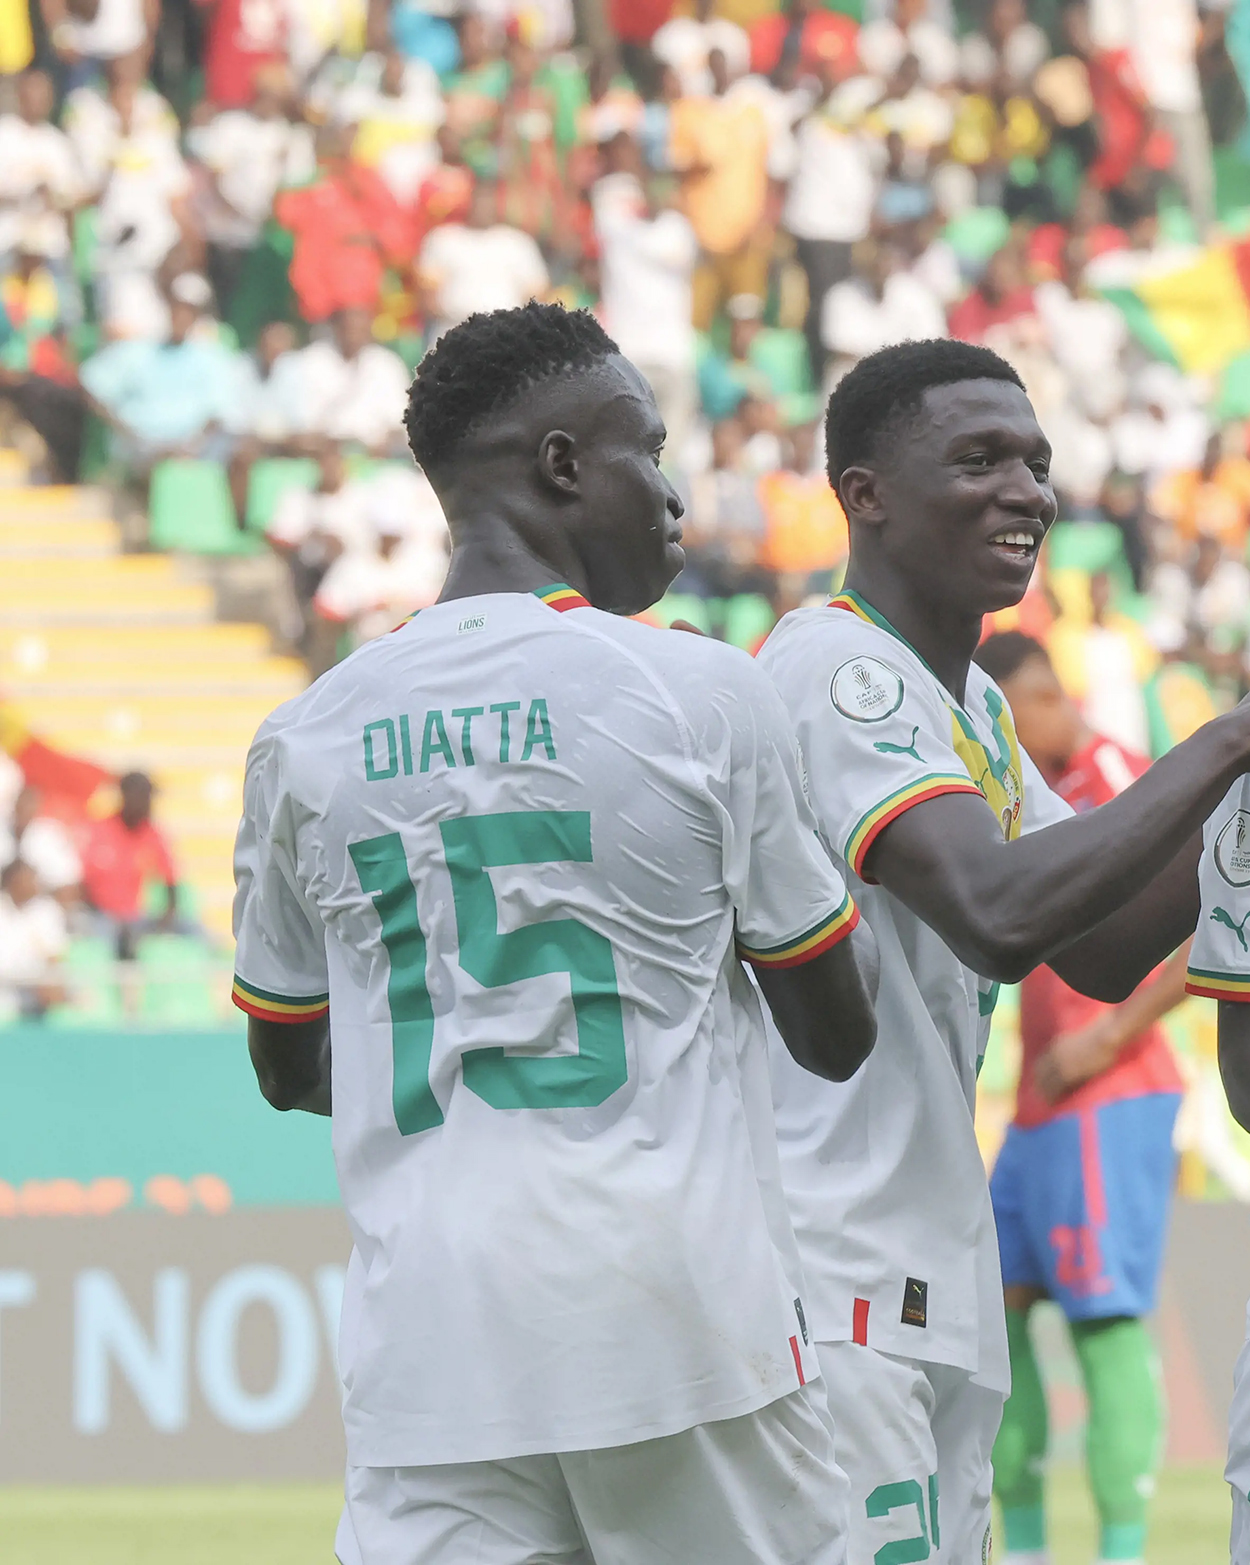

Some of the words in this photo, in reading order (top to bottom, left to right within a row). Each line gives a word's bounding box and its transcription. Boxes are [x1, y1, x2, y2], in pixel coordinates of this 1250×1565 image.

[459, 617, 485, 631] LIONS
[363, 699, 557, 781] DIATTA
[348, 810, 628, 1136] 15
[73, 1262, 346, 1435] NO
[865, 1472, 940, 1565] 2
